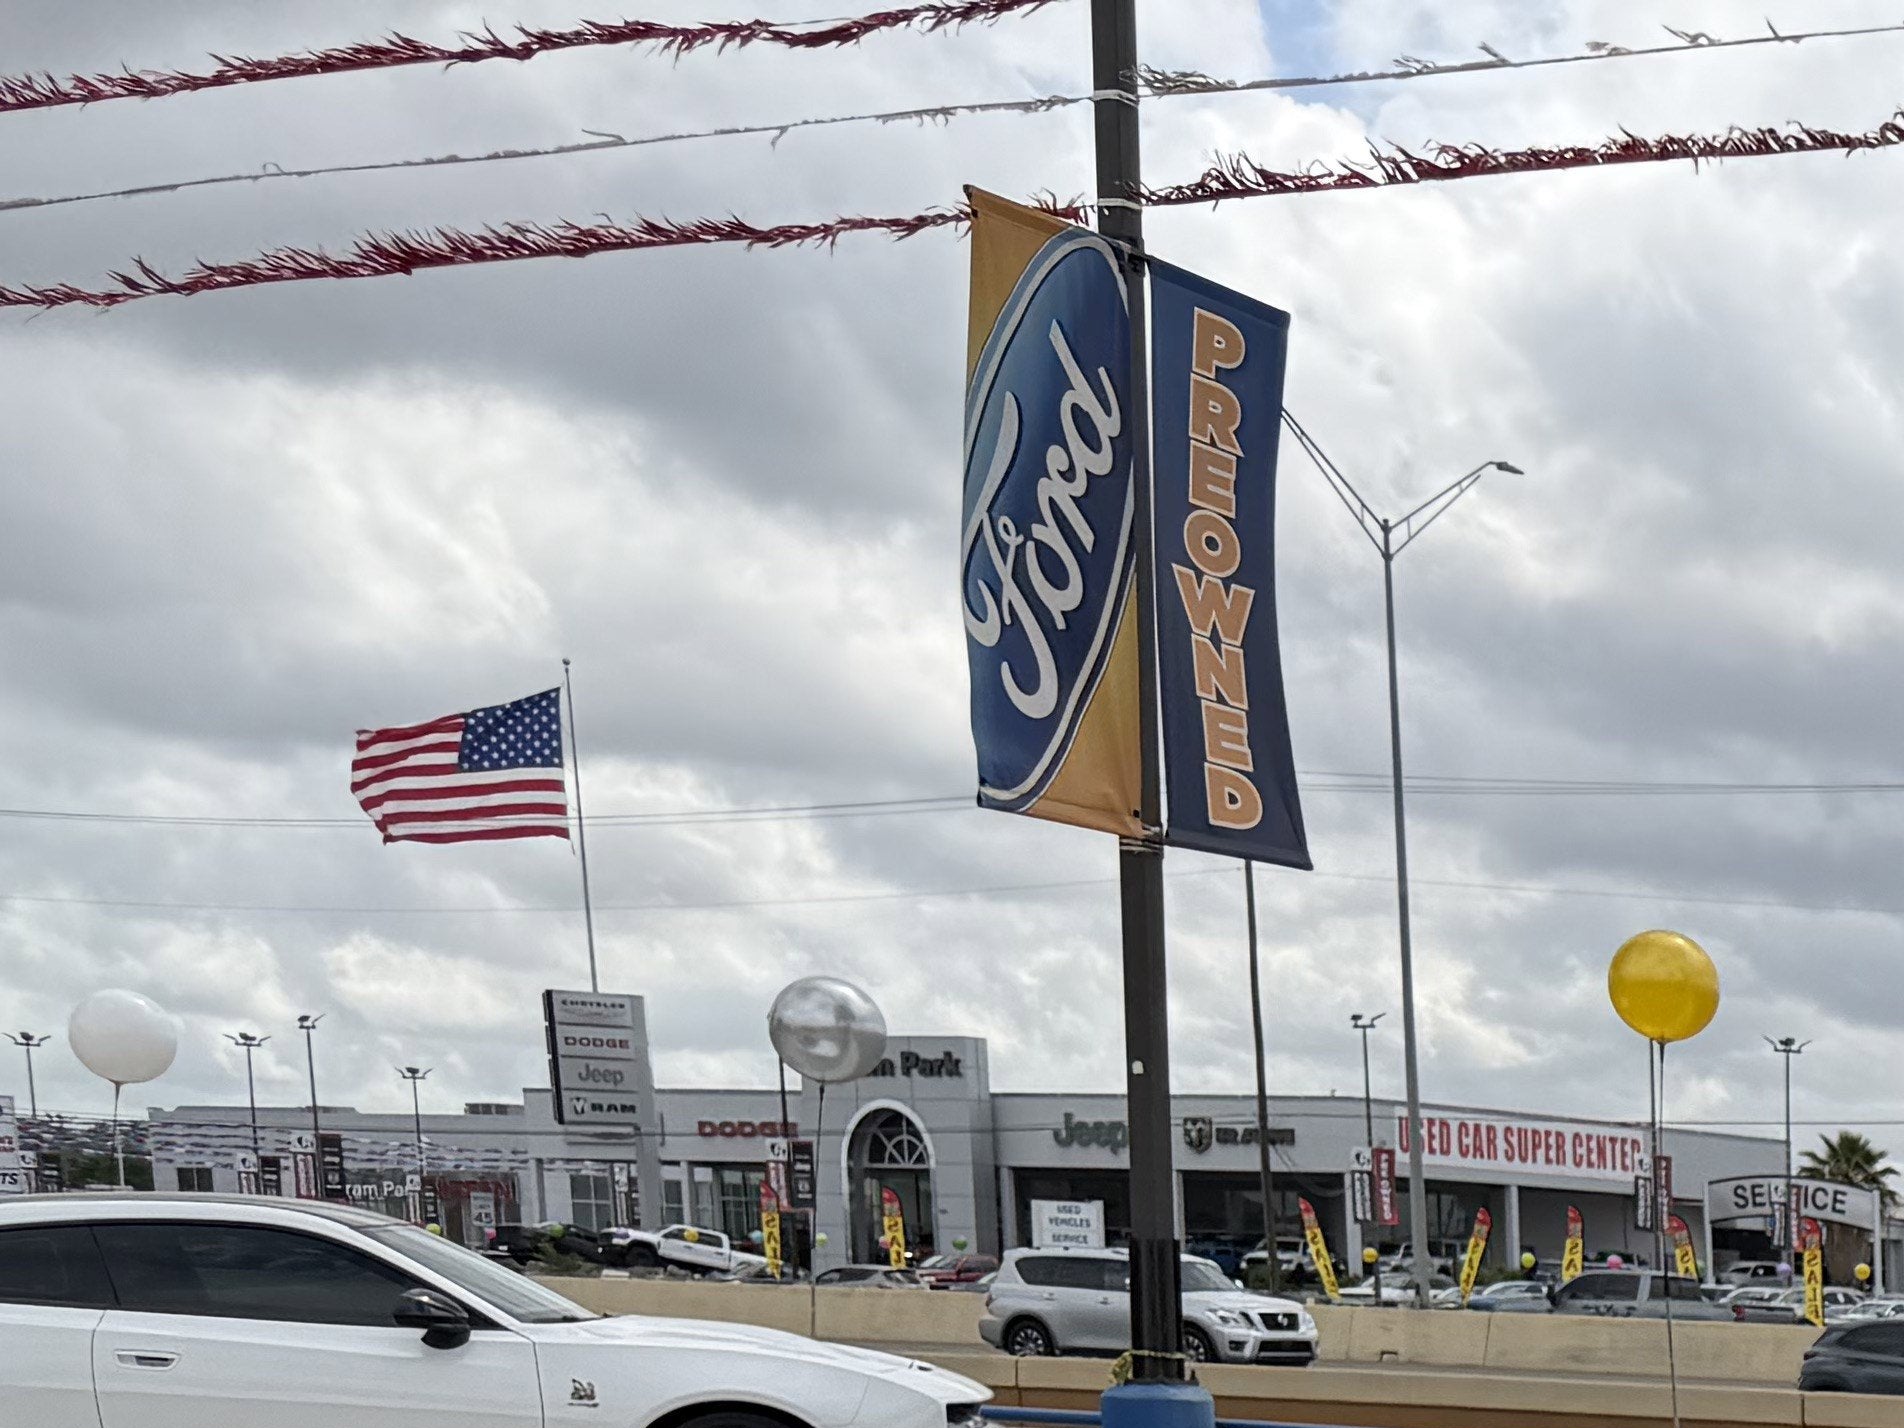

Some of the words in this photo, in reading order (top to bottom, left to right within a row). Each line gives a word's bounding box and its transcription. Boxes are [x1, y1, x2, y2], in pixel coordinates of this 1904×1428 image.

[962, 319, 1124, 721] Ford
[1171, 307, 1264, 831] PREOWNED
[564, 1036, 631, 1050] DODGE
[578, 1062, 625, 1088] Jeep
[900, 1050, 963, 1078] Park
[590, 1102, 637, 1115] RAM
[697, 1120, 799, 1139] DODGE
[1398, 1115, 1452, 1157] UED
[1457, 1120, 1499, 1162] CAR
[1503, 1124, 1568, 1167] SUPER
[1733, 1181, 1848, 1216] SEICE
